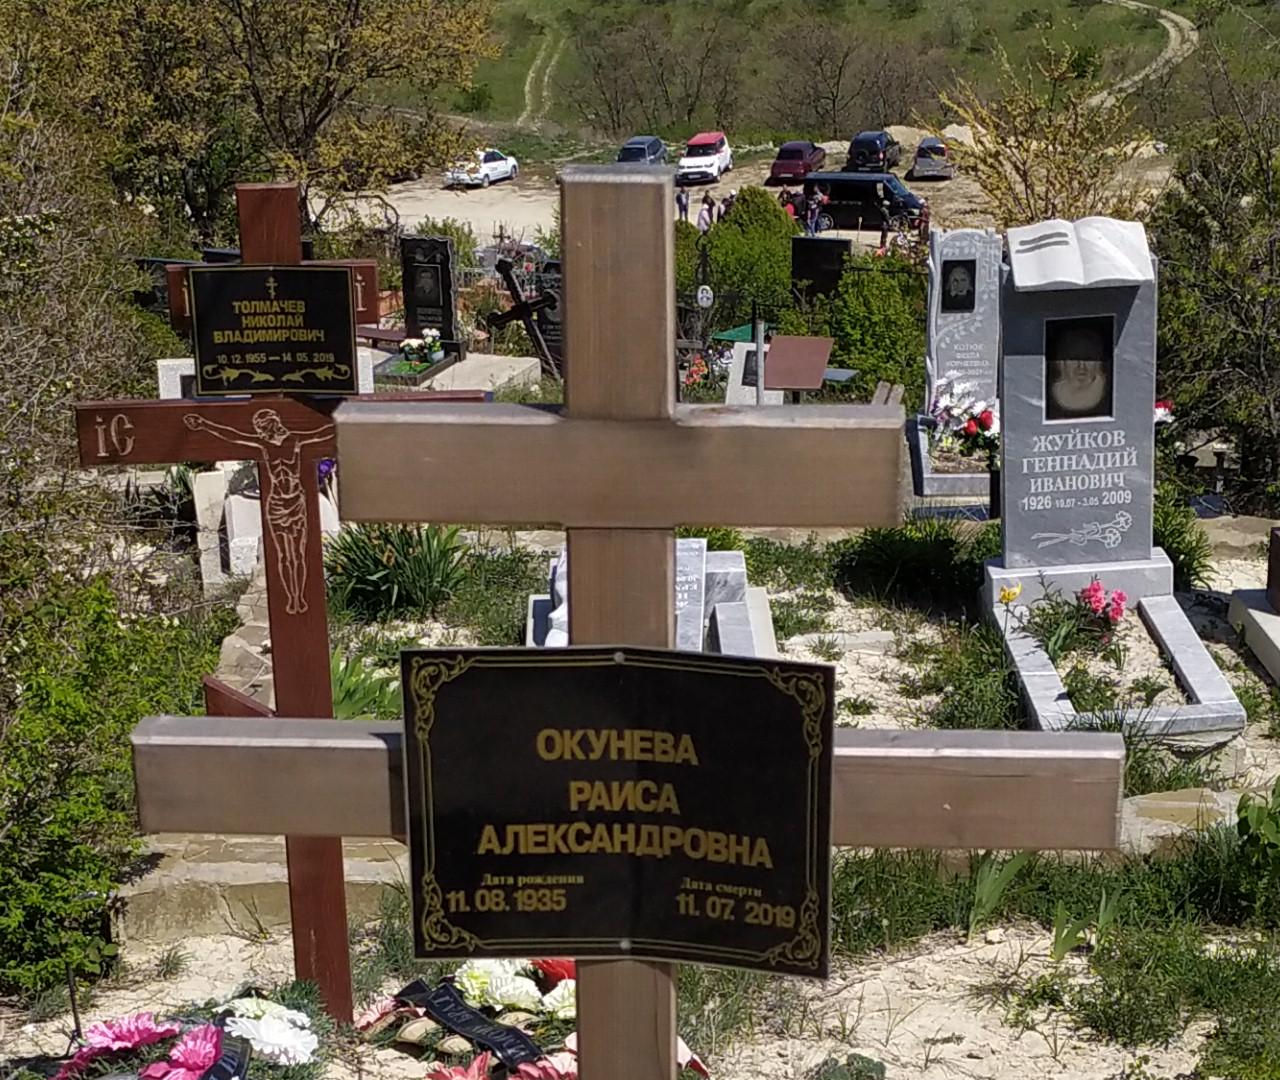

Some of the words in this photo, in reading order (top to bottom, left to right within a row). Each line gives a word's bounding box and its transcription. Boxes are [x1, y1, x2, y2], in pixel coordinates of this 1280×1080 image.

[232, 300, 305, 314] ТОЛМАЧЕВ
[242, 314, 304, 328] НИКОЛАЙ
[213, 329, 325, 344] ВЛАДИМИРОВИЧ
[1032, 428, 1126, 452] ЖУЙКОВ
[1021, 446, 1138, 474] ГЕННАДИЙ
[1030, 472, 1126, 493] ИВАНОВИЧ
[1022, 495, 1052, 510] 1926
[1102, 490, 1132, 505] 2009
[537, 728, 699, 766] ОКУНЕВА
[569, 780, 681, 816] РАИСА
[477, 822, 773, 869] АЛЕКСАНДРОВНА
[481, 873, 514, 886] Дата
[518, 874, 585, 888] рождения
[681, 876, 713, 891] Дата
[715, 883, 762, 898] смерти
[513, 889, 567, 912] 1935
[744, 902, 796, 928] 2019
